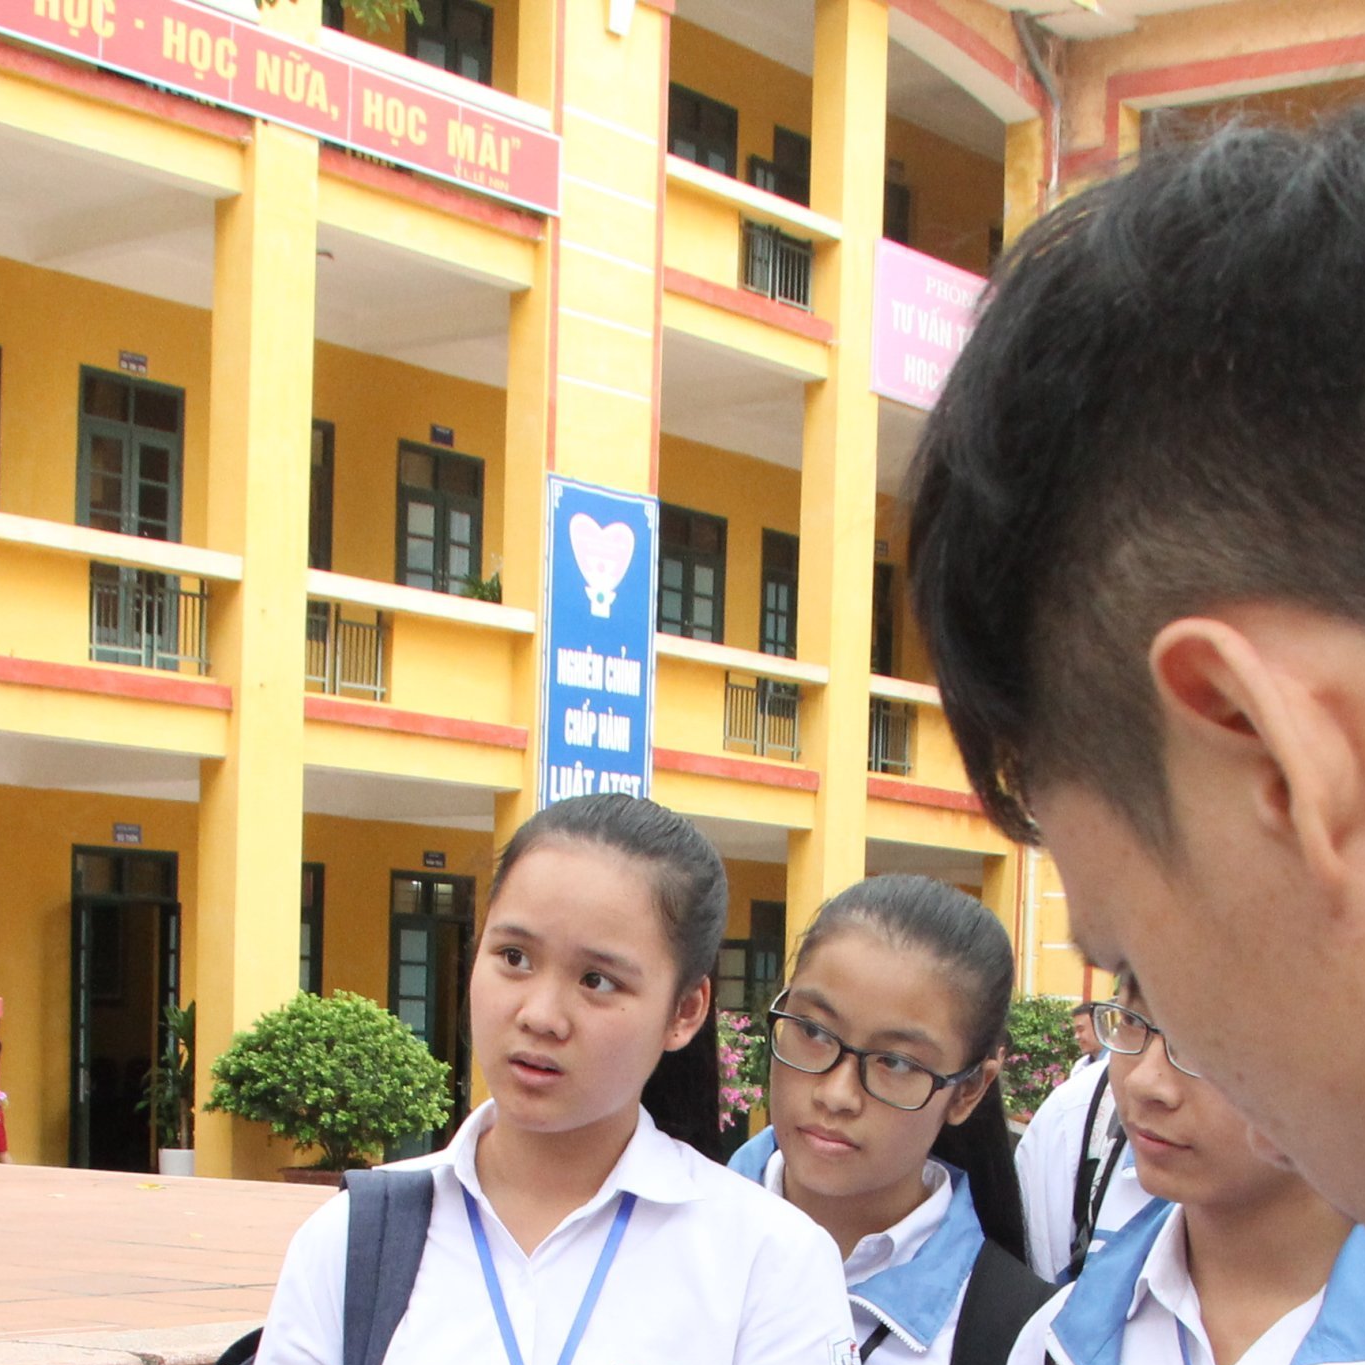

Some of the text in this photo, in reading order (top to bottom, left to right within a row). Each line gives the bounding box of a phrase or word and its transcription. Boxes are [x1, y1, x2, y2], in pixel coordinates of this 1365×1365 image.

[163, 16, 238, 81] HỌC
[256, 50, 340, 122] NỮA,
[363, 88, 428, 147] HỌC
[925, 274, 976, 308] PHÒN
[917, 306, 953, 350] VẤN
[903, 353, 940, 395] HỌC
[556, 645, 604, 691] NGHIÊM
[564, 698, 631, 753] CHẤP HÀNH
